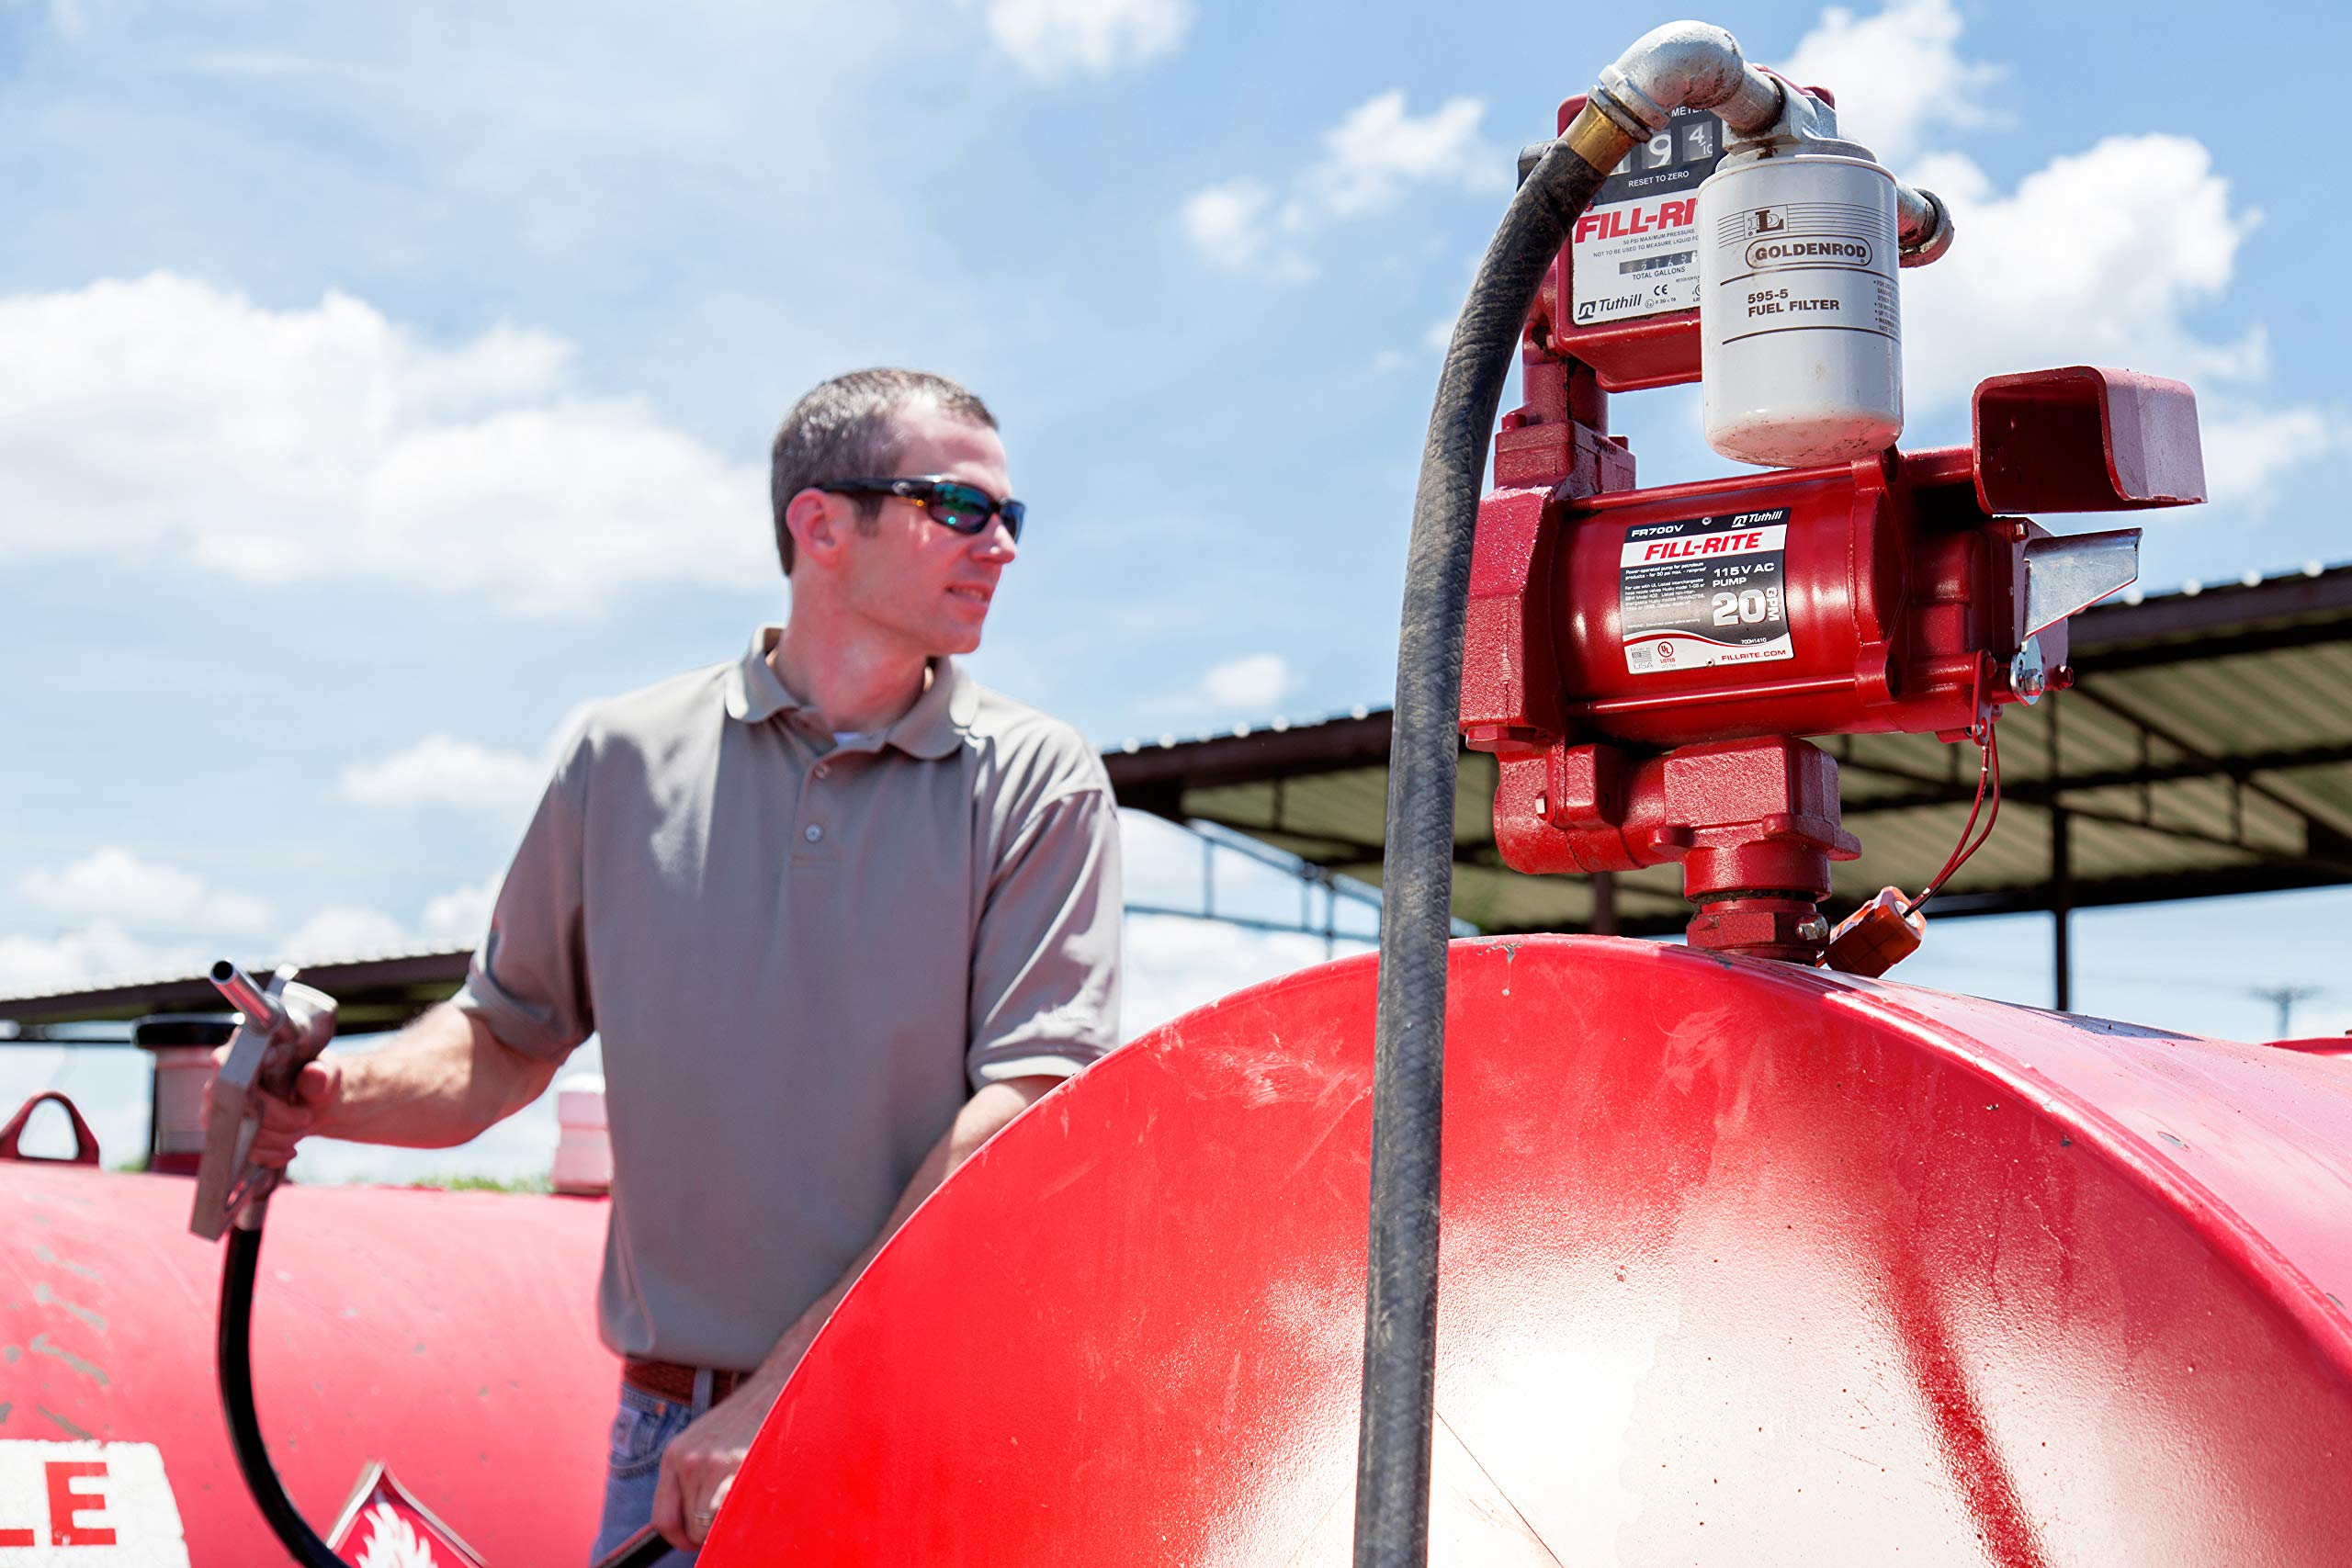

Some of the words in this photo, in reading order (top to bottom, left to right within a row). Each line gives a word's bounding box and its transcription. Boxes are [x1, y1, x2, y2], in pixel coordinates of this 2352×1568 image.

[1671, 106, 1707, 118] METE
[1628, 176, 1653, 187] RESET
[1668, 170, 1690, 181] ZERO
[1575, 197, 1698, 243] FILL-RI
[1640, 233, 1666, 243] MAXIMUM
[1667, 228, 1696, 238] PRESSURE
[1646, 240, 1672, 249] MEASURE
[1673, 236, 1691, 245] LIQUID
[1755, 243, 1867, 261] GOLDENROD
[1654, 266, 1686, 277] GALLONS
[1654, 284, 1668, 296] CE
[1747, 288, 1789, 304] 595-5
[1599, 293, 1642, 312] Tuthill
[1747, 303, 1784, 317] FUEL
[1790, 299, 1840, 311] FILTER
[1747, 511, 1782, 523] Tuthill
[1631, 525, 1684, 537] FR700V
[1644, 532, 1763, 561] FILL-RITE
[1625, 567, 1660, 575] Power-operated
[1753, 562, 1775, 573] AC
[1713, 577, 1747, 588] PUMP
[1712, 589, 1767, 626] 20
[1766, 587, 1781, 622] GPM
[1721, 649, 1786, 661] FILLRITE.COM
[1633, 661, 1653, 670] USA
[0, 1461, 117, 1546] E
